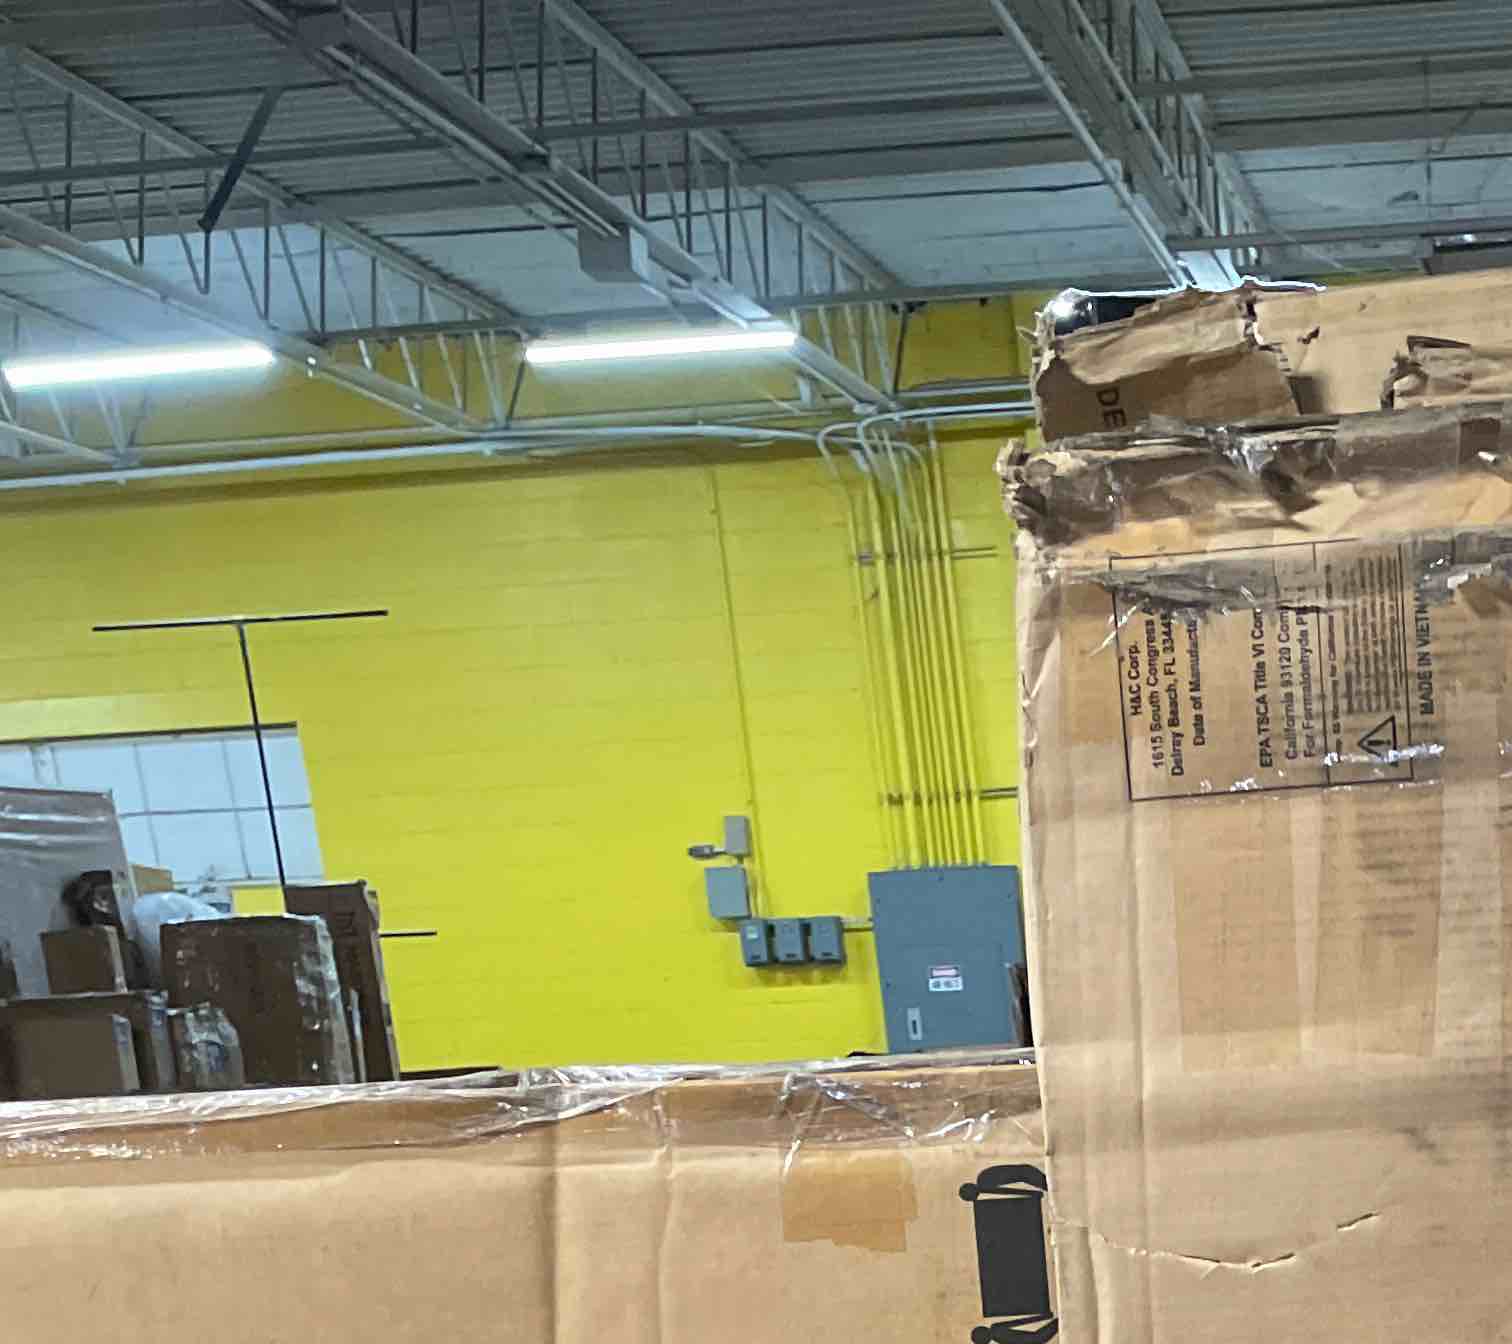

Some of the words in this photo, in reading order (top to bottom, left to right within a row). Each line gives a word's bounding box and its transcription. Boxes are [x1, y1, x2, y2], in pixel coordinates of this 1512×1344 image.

[1127, 641, 1141, 680] Corp.
[1144, 620, 1160, 687] Congress
[1164, 657, 1176, 675] FL
[1253, 644, 1265, 658] VI
[1278, 647, 1291, 688] 93120
[1416, 652, 1432, 666] IN
[1253, 661, 1267, 691] Title
[1297, 630, 1315, 730] Formaldehyde
[1417, 670, 1434, 715] MADE
[1128, 684, 1142, 716] H&C
[1148, 691, 1162, 732] South
[1165, 679, 1180, 727] Beach,
[1190, 695, 1201, 710] of
[1256, 695, 1270, 736] TSCA
[1192, 714, 1205, 746] Date
[1279, 692, 1298, 760] California
[1150, 736, 1164, 768] 1615
[1168, 731, 1184, 776] Delray
[1257, 737, 1273, 768] EPA
[1302, 735, 1315, 758] For
